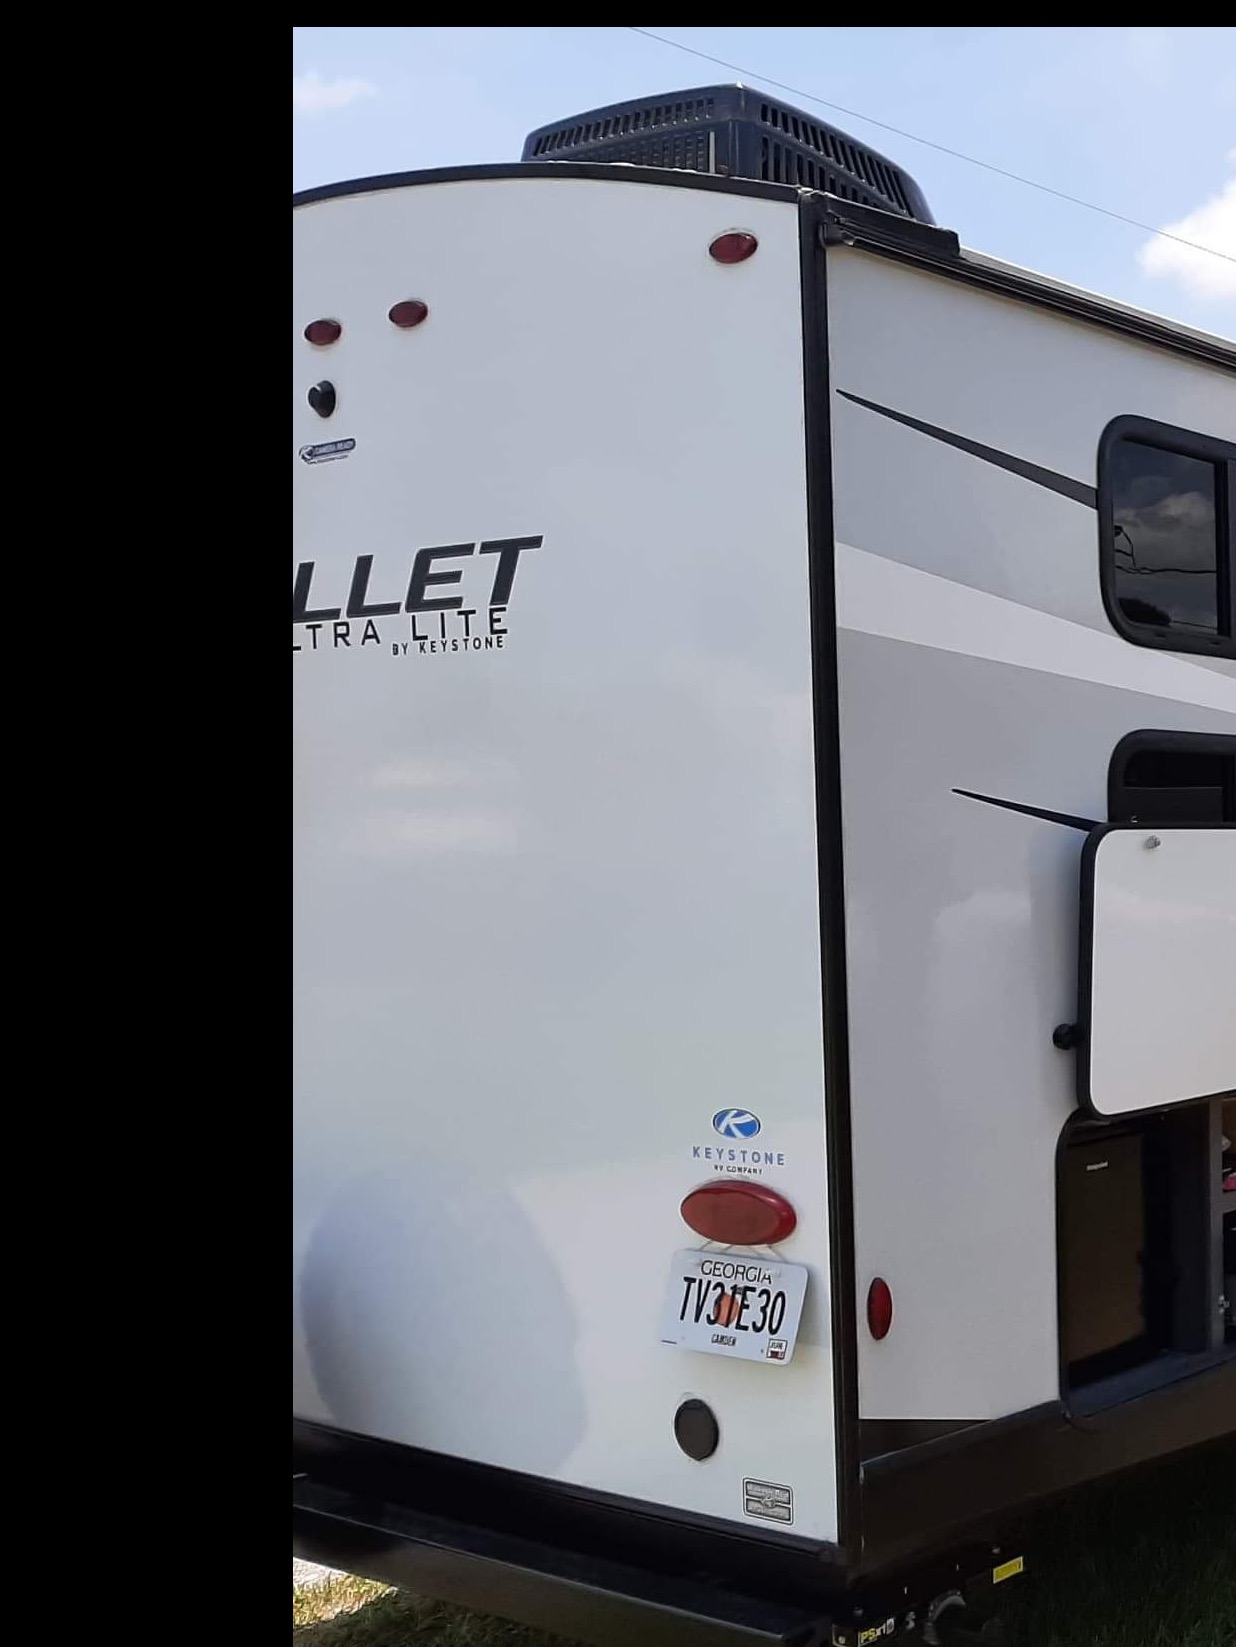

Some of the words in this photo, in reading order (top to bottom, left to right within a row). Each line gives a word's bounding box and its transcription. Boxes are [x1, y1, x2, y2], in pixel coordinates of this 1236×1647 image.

[411, 606, 508, 641] LITE
[392, 642, 409, 656] BY
[419, 635, 504, 654] KEYSTONE
[692, 1146, 785, 1166] KEYSTONE
[701, 1259, 772, 1285] GEORGIA
[680, 1276, 787, 1336] TV31E30
